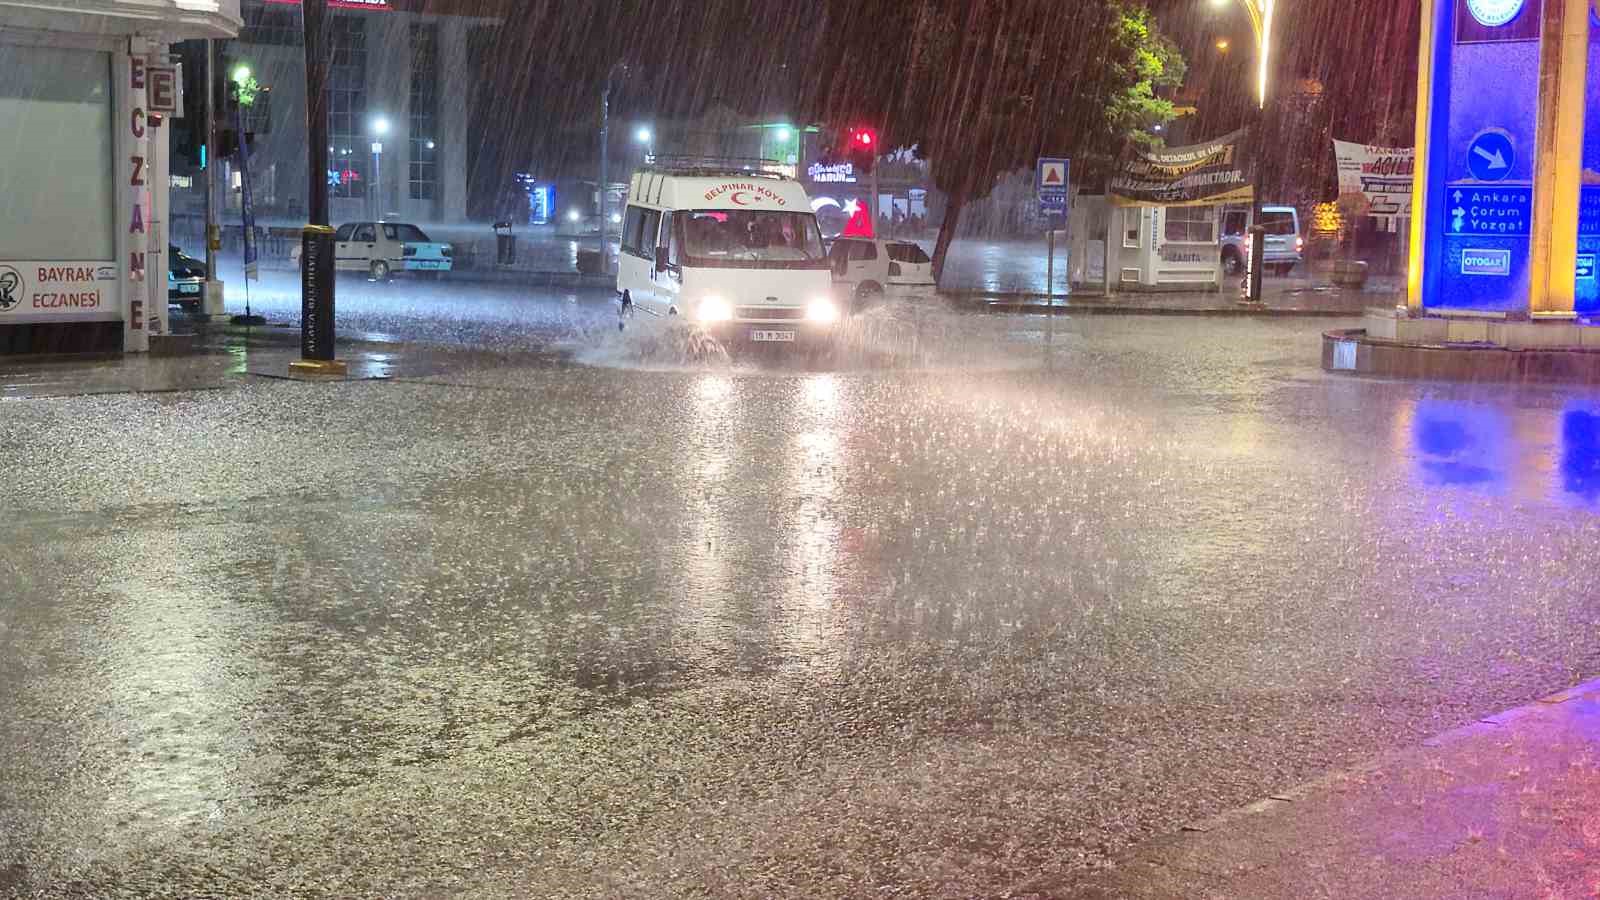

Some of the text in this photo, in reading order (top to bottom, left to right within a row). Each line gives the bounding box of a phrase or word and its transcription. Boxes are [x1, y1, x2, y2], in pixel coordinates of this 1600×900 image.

[130, 58, 145, 330] ECZANE
[1471, 192, 1526, 203] Ankara
[1470, 206, 1520, 217] Çorum
[1471, 219, 1523, 233] Yozgat
[38, 267, 95, 282] BAYRAK
[32, 288, 100, 308] ECZANESİ
